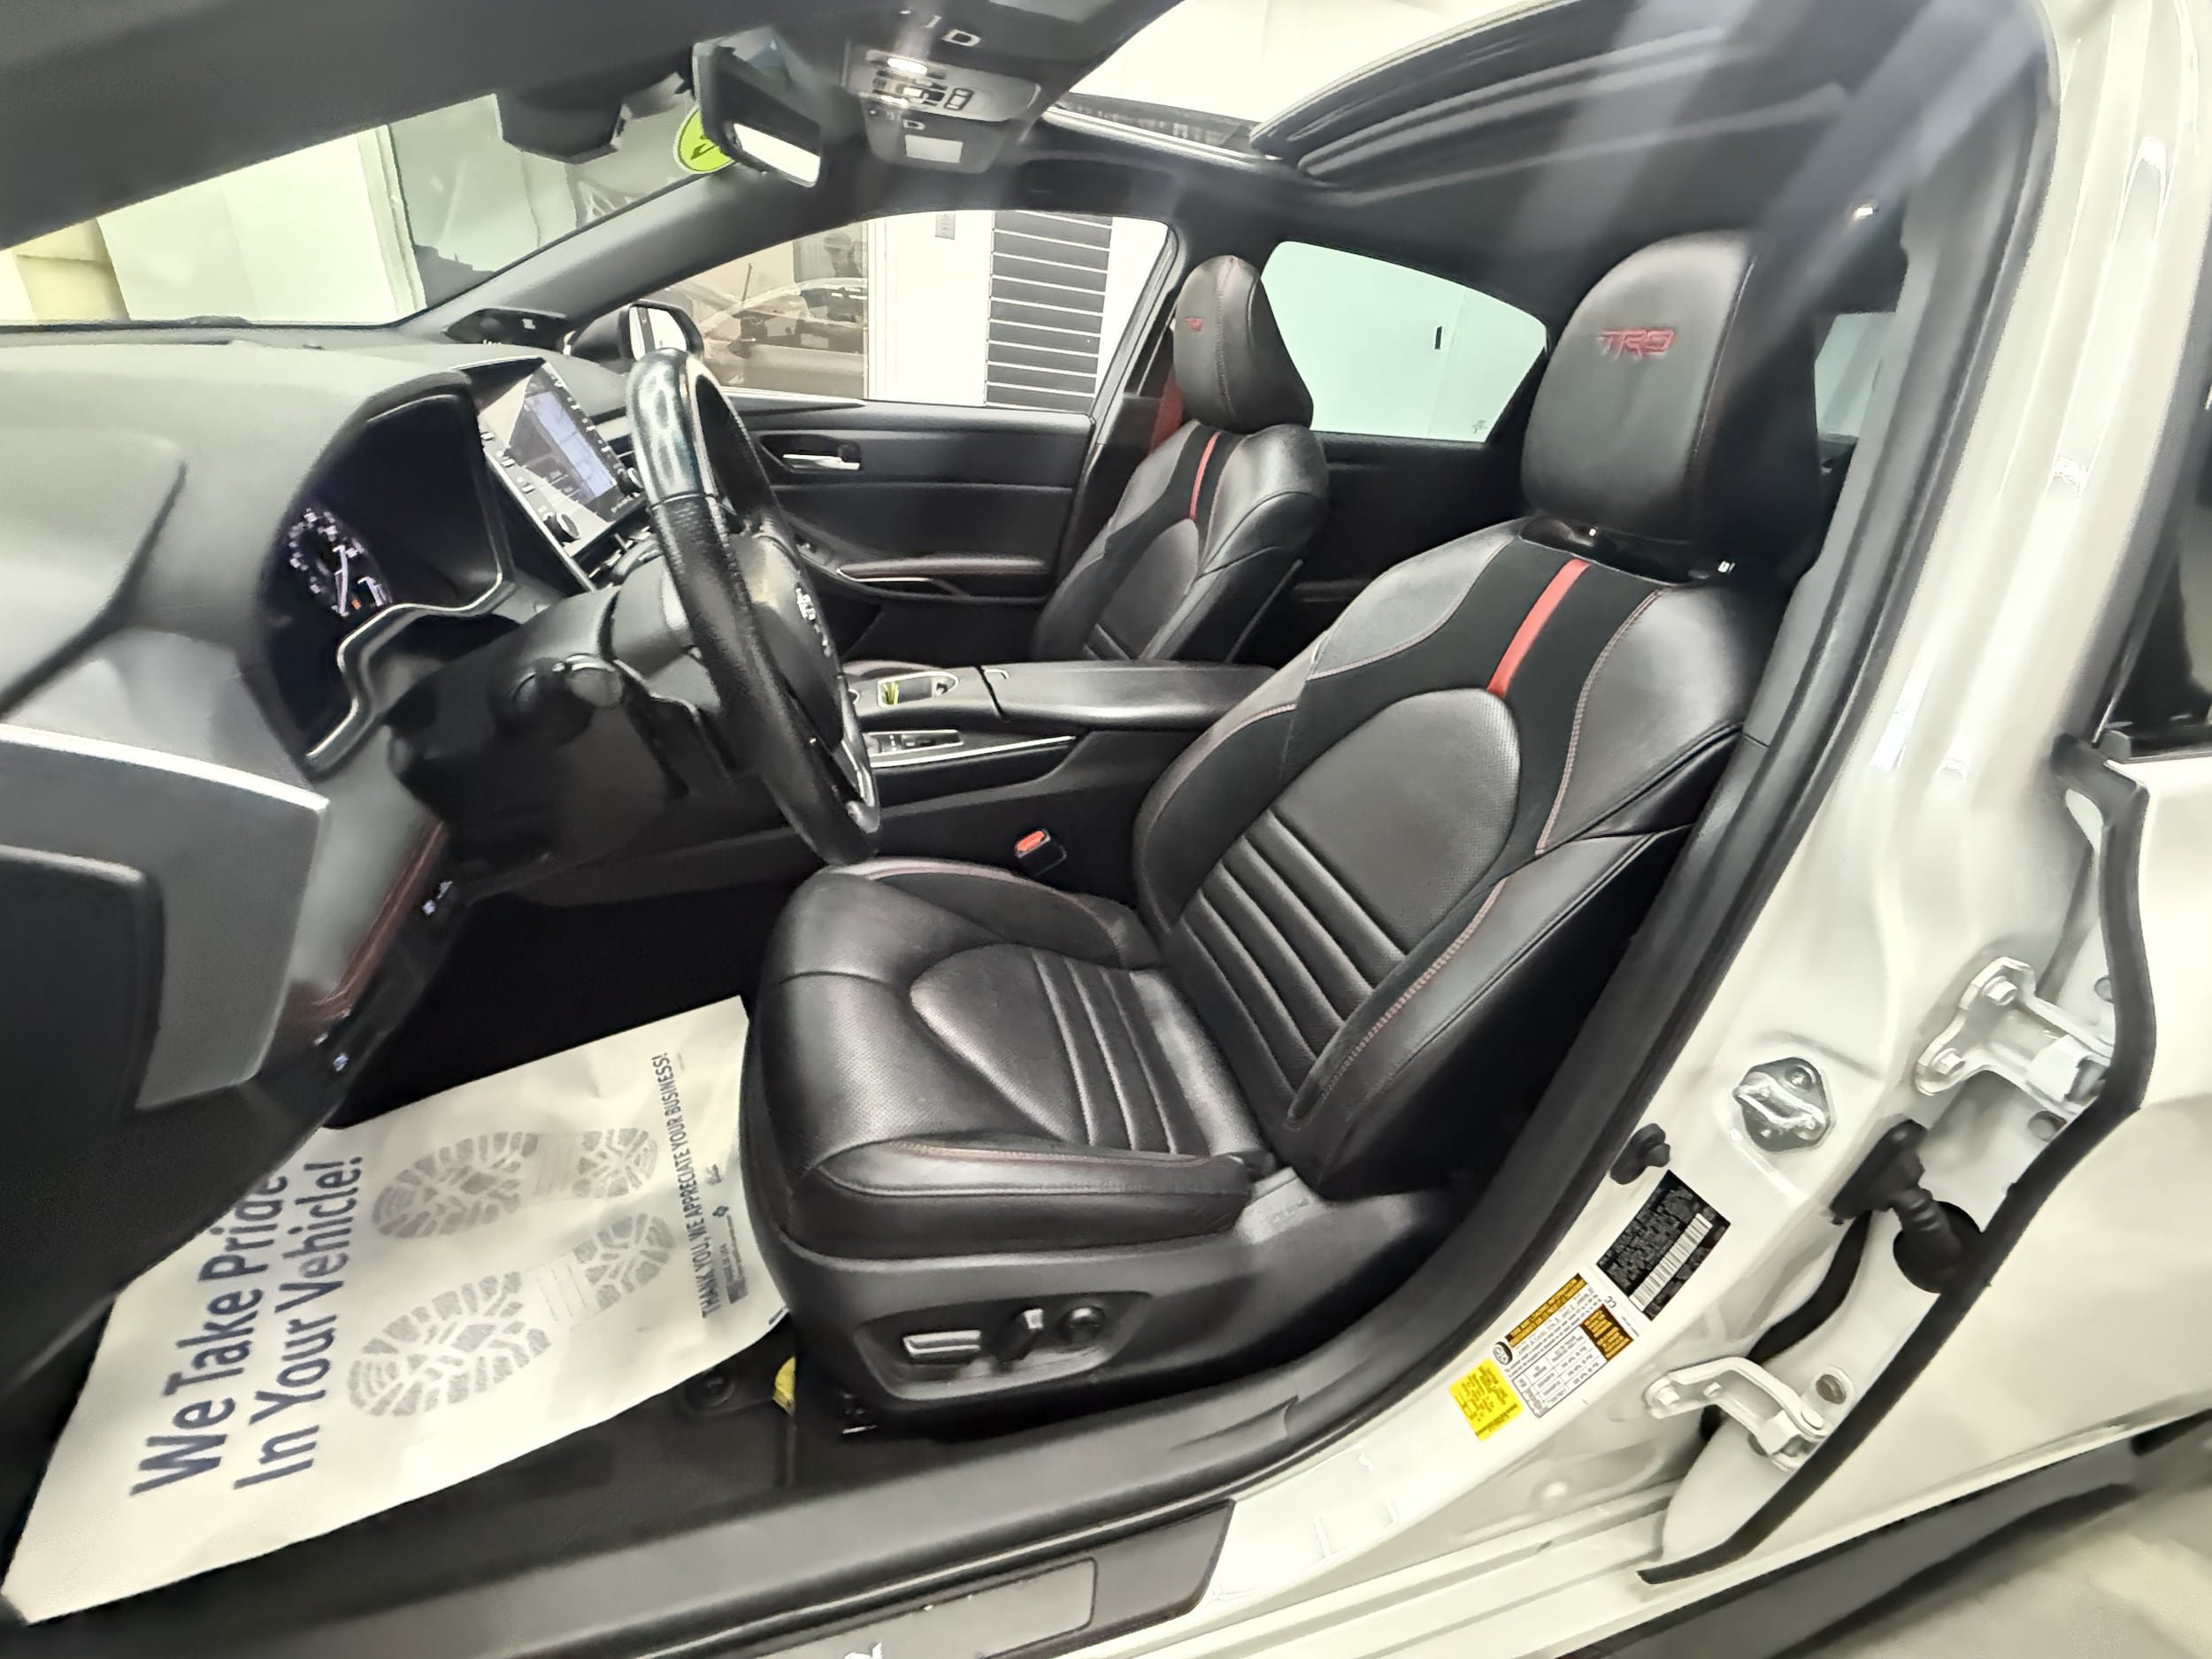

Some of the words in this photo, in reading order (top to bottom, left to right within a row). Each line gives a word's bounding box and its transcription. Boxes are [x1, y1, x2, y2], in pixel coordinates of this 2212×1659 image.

[651, 1052, 681, 1117] BUSINESS!
[666, 1115, 688, 1151] YOUR
[673, 1148, 704, 1218] APPRECIATE
[274, 1156, 363, 1313] Vehicle!
[686, 1217, 707, 1242] WE
[695, 1268, 721, 1318] THANK
[163, 1288, 263, 1396] Take
[248, 1315, 338, 1425] Your
[129, 1397, 236, 1495] We
[233, 1425, 320, 1489] In
